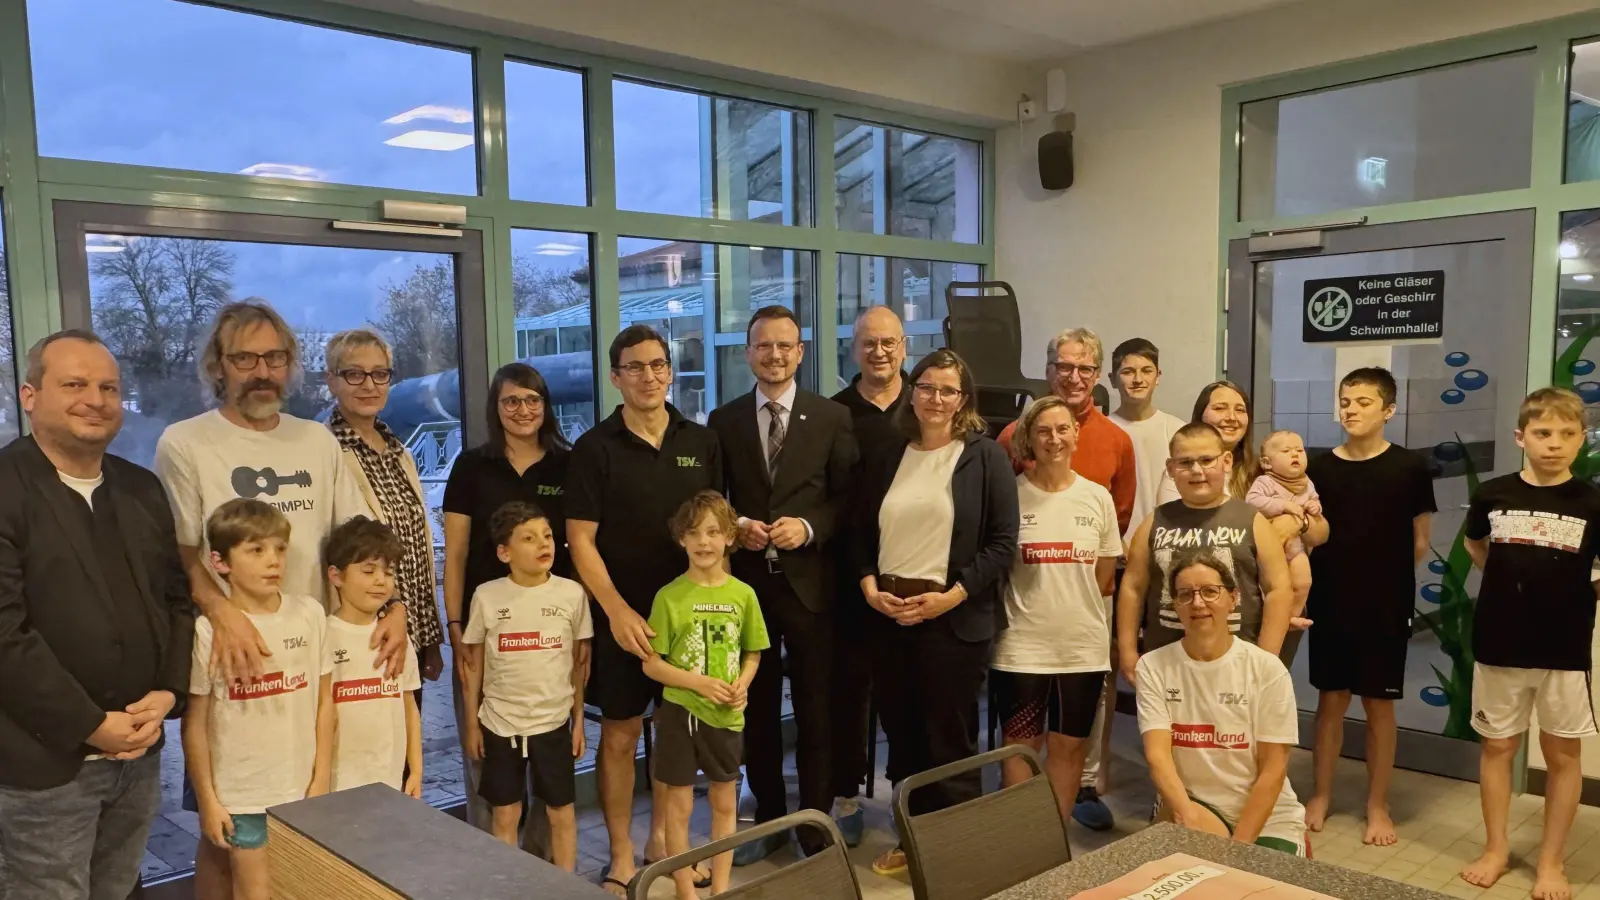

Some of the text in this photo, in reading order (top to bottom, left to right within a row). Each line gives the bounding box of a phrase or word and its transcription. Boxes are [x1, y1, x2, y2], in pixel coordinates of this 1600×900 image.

[1358, 277, 1434, 290] Keine Gläser
[1355, 292, 1436, 305] oder Geschirr
[1392, 308, 1411, 319] der
[1350, 322, 1439, 336] Schwimmhalle!
[676, 456, 697, 467] TSV
[537, 485, 560, 496] TSV
[1074, 516, 1095, 527] TSV
[1153, 526, 1247, 549] RELAX NOW
[541, 607, 559, 617] TSV
[283, 636, 304, 650] TSV
[1218, 692, 1245, 705] TSV
